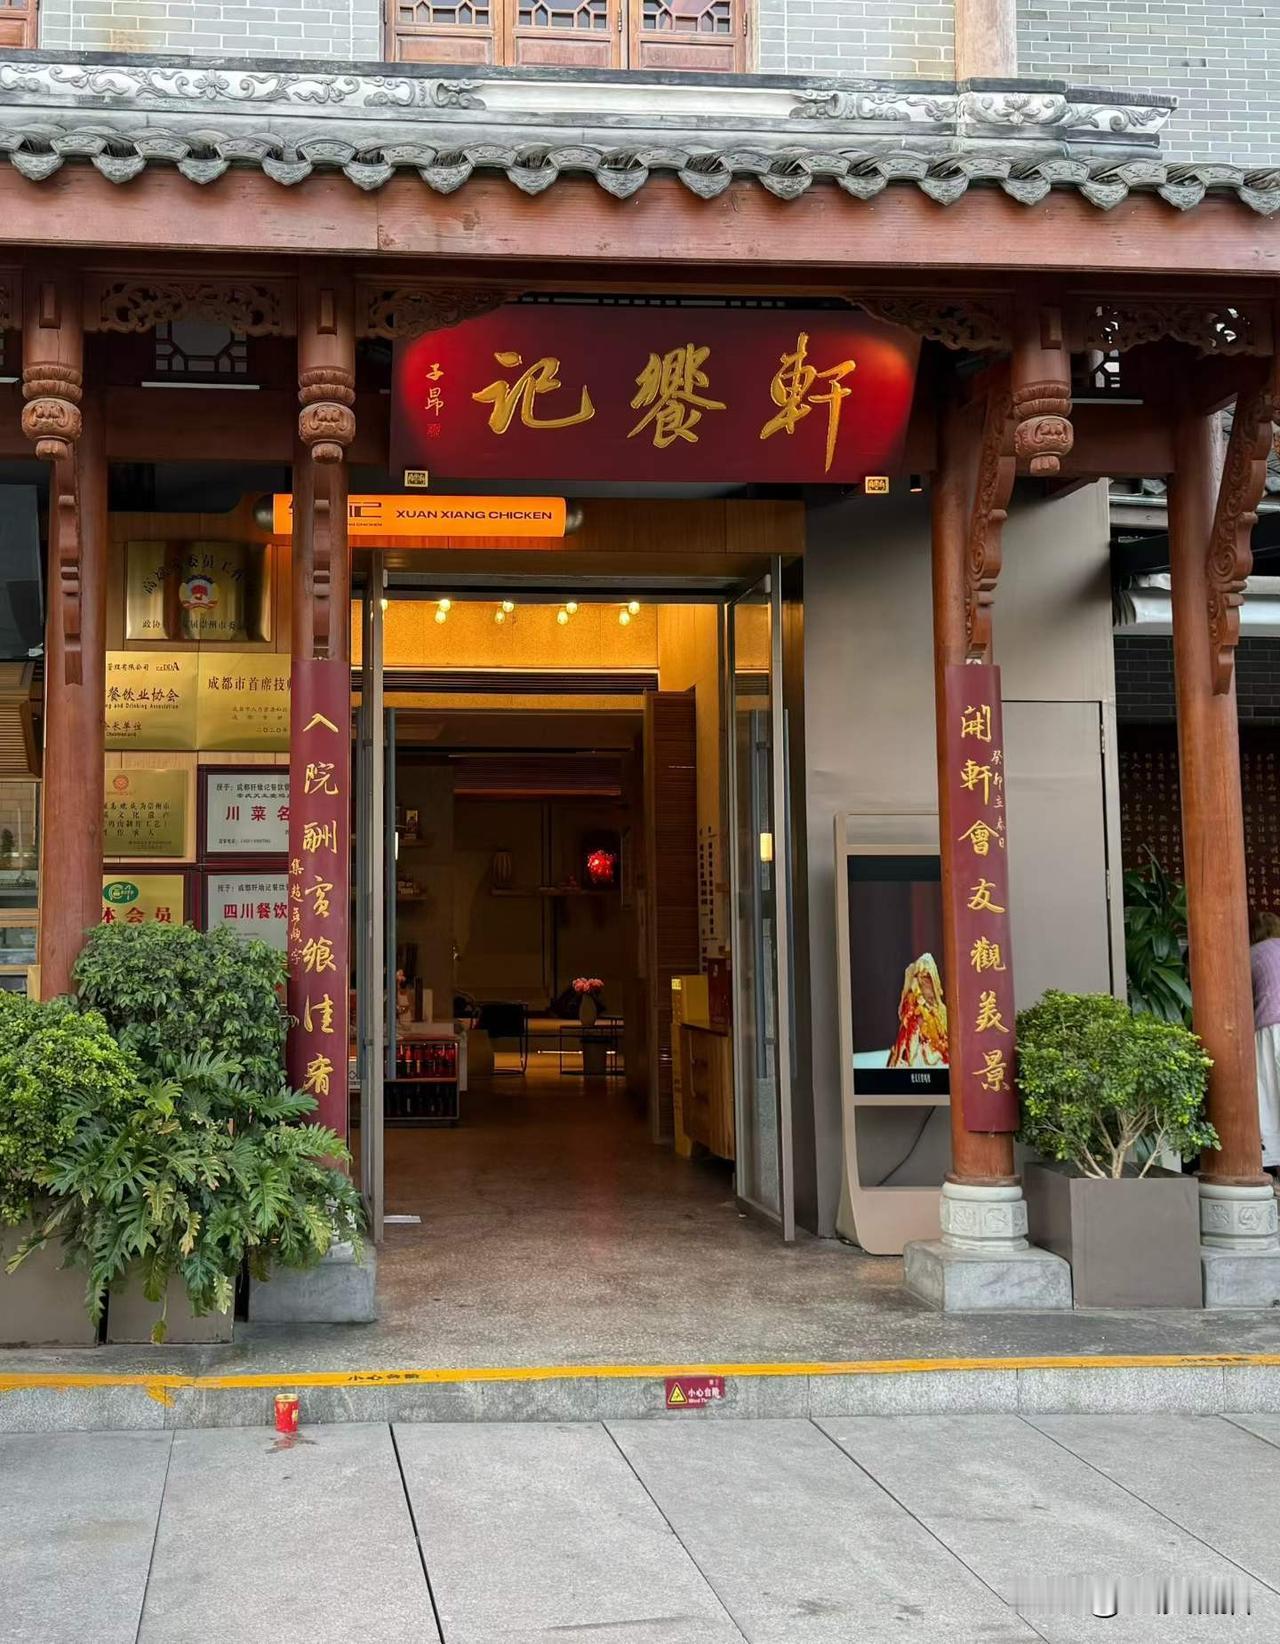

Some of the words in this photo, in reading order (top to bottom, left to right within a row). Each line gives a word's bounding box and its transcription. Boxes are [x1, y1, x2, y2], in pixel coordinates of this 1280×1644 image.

[396, 510, 437, 520] XUAN
[441, 511, 486, 520] XIANG
[489, 511, 552, 521] CHICKEN
[224, 903, 288, 919] 四川餐饮
